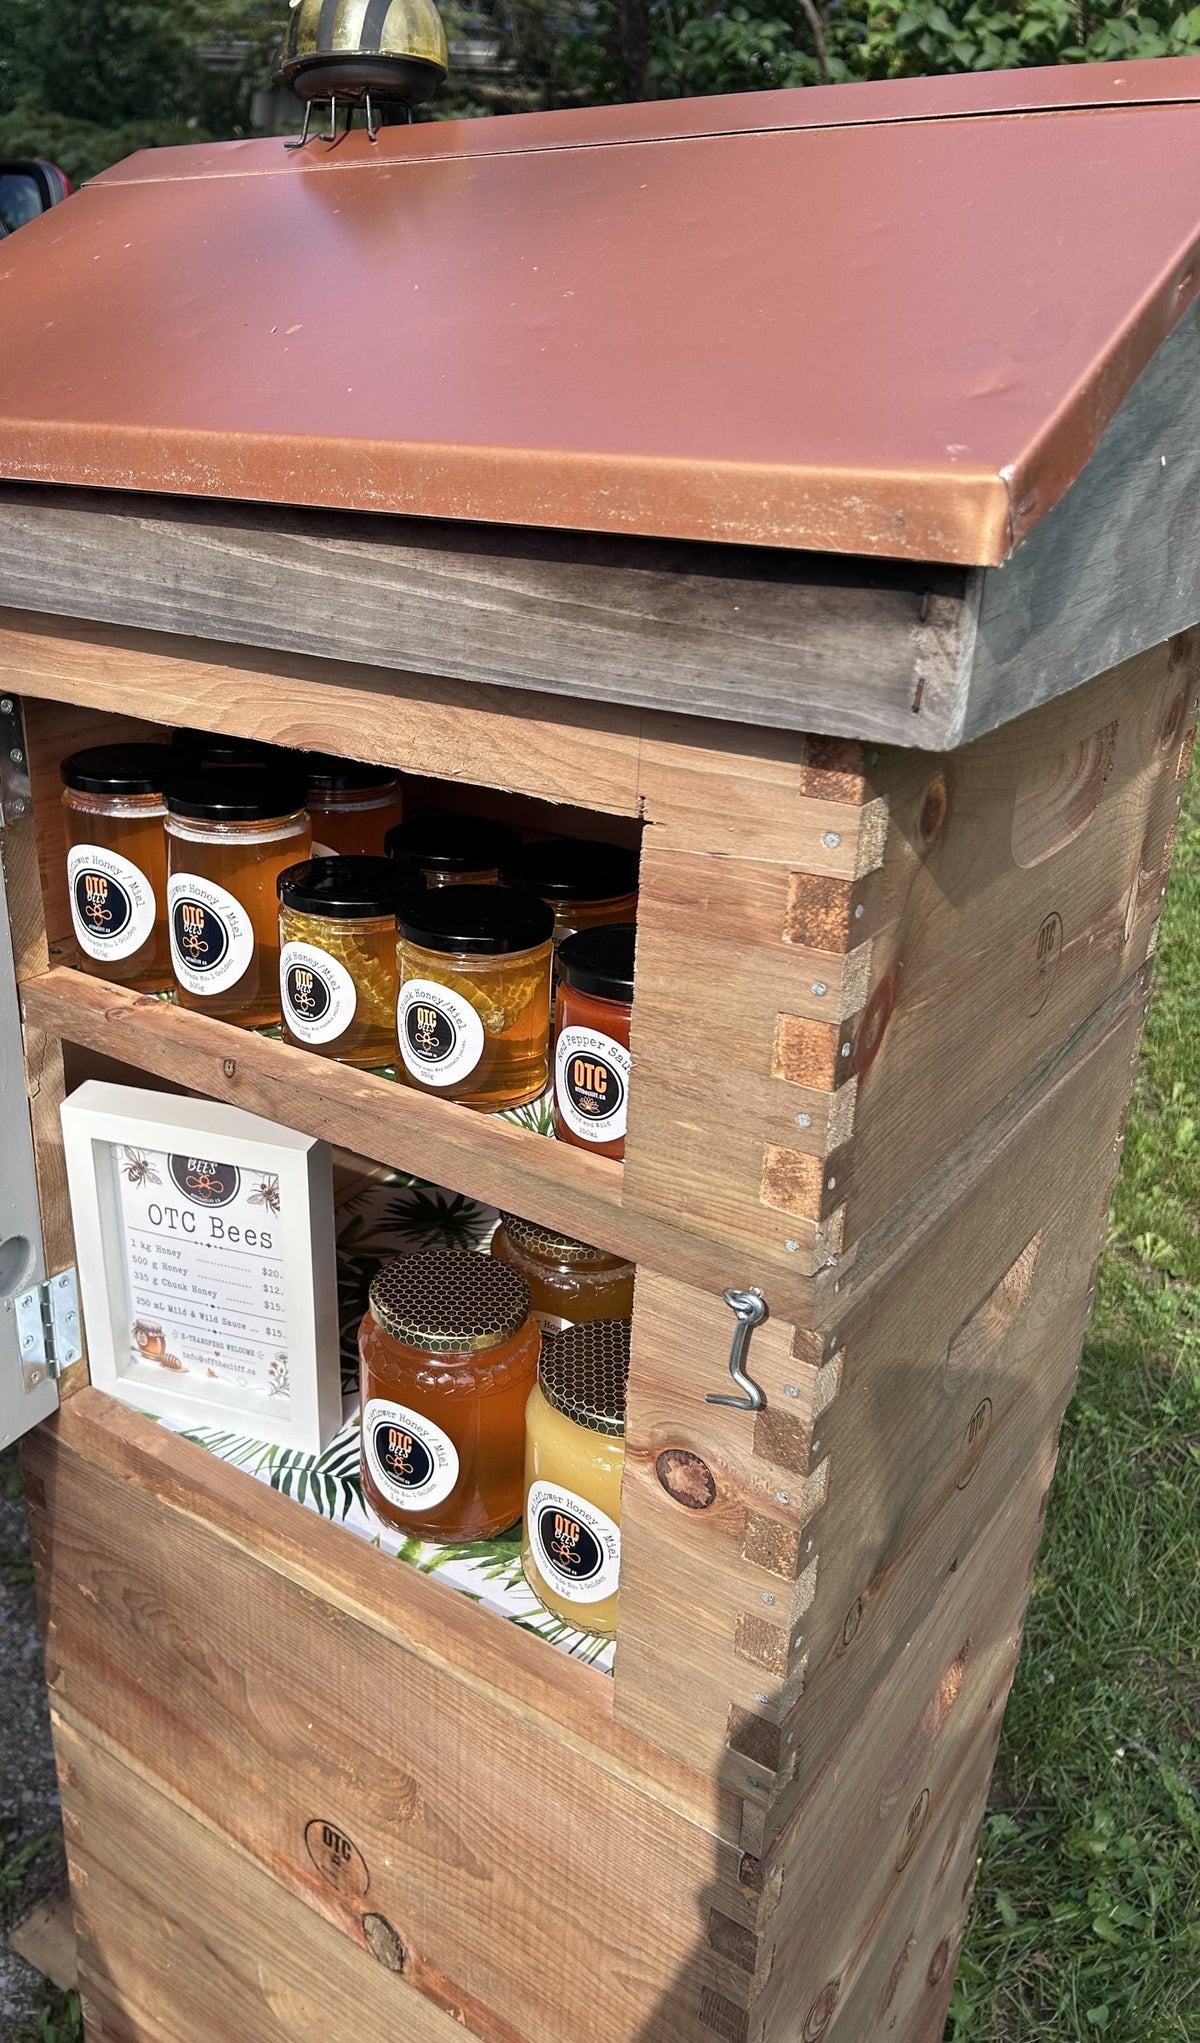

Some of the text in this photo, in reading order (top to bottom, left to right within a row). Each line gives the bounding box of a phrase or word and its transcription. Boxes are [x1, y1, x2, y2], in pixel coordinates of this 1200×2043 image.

[85, 875, 108, 897] OTC
[91, 855, 123, 875] Honey
[129, 882, 145, 908] Miel
[87, 892, 107, 904] BEES
[189, 883, 219, 905] Honey
[226, 912, 242, 940] Miel
[182, 905, 204, 929] OTC
[184, 923, 202, 935] BEES
[1037, 919, 1056, 960] OTC
[215, 958, 234, 977] Golden
[295, 969, 313, 989] OTC
[417, 1007, 437, 1028] OTC
[557, 1035, 631, 1076] Red Pepper Sau
[574, 1059, 607, 1094] OTC
[187, 1158, 218, 1174] BEES
[148, 1203, 273, 1249] OTC Bees
[131, 1239, 283, 1279] 1 kg Honey $20.
[132, 1255, 284, 1296] 500 g Honey $12.
[134, 1271, 285, 1312] 335 g Chunk Honey $15.
[136, 1297, 286, 1338] 250 mL Mild & Wild Sauce $15.
[226, 1344, 256, 1357] WELCOME
[968, 1404, 986, 1444] OTC
[389, 1428, 412, 1453] OTC
[389, 1443, 409, 1459] BEES
[399, 1413, 430, 1437] Honey
[434, 1444, 448, 1468] Miel
[554, 1513, 580, 1543] OTC
[554, 1530, 576, 1547] BEES
[566, 1498, 599, 1525] Honey
[603, 1535, 619, 1560] Miel
[584, 1575, 606, 1589] Golden
[323, 1825, 351, 1861] OTC
